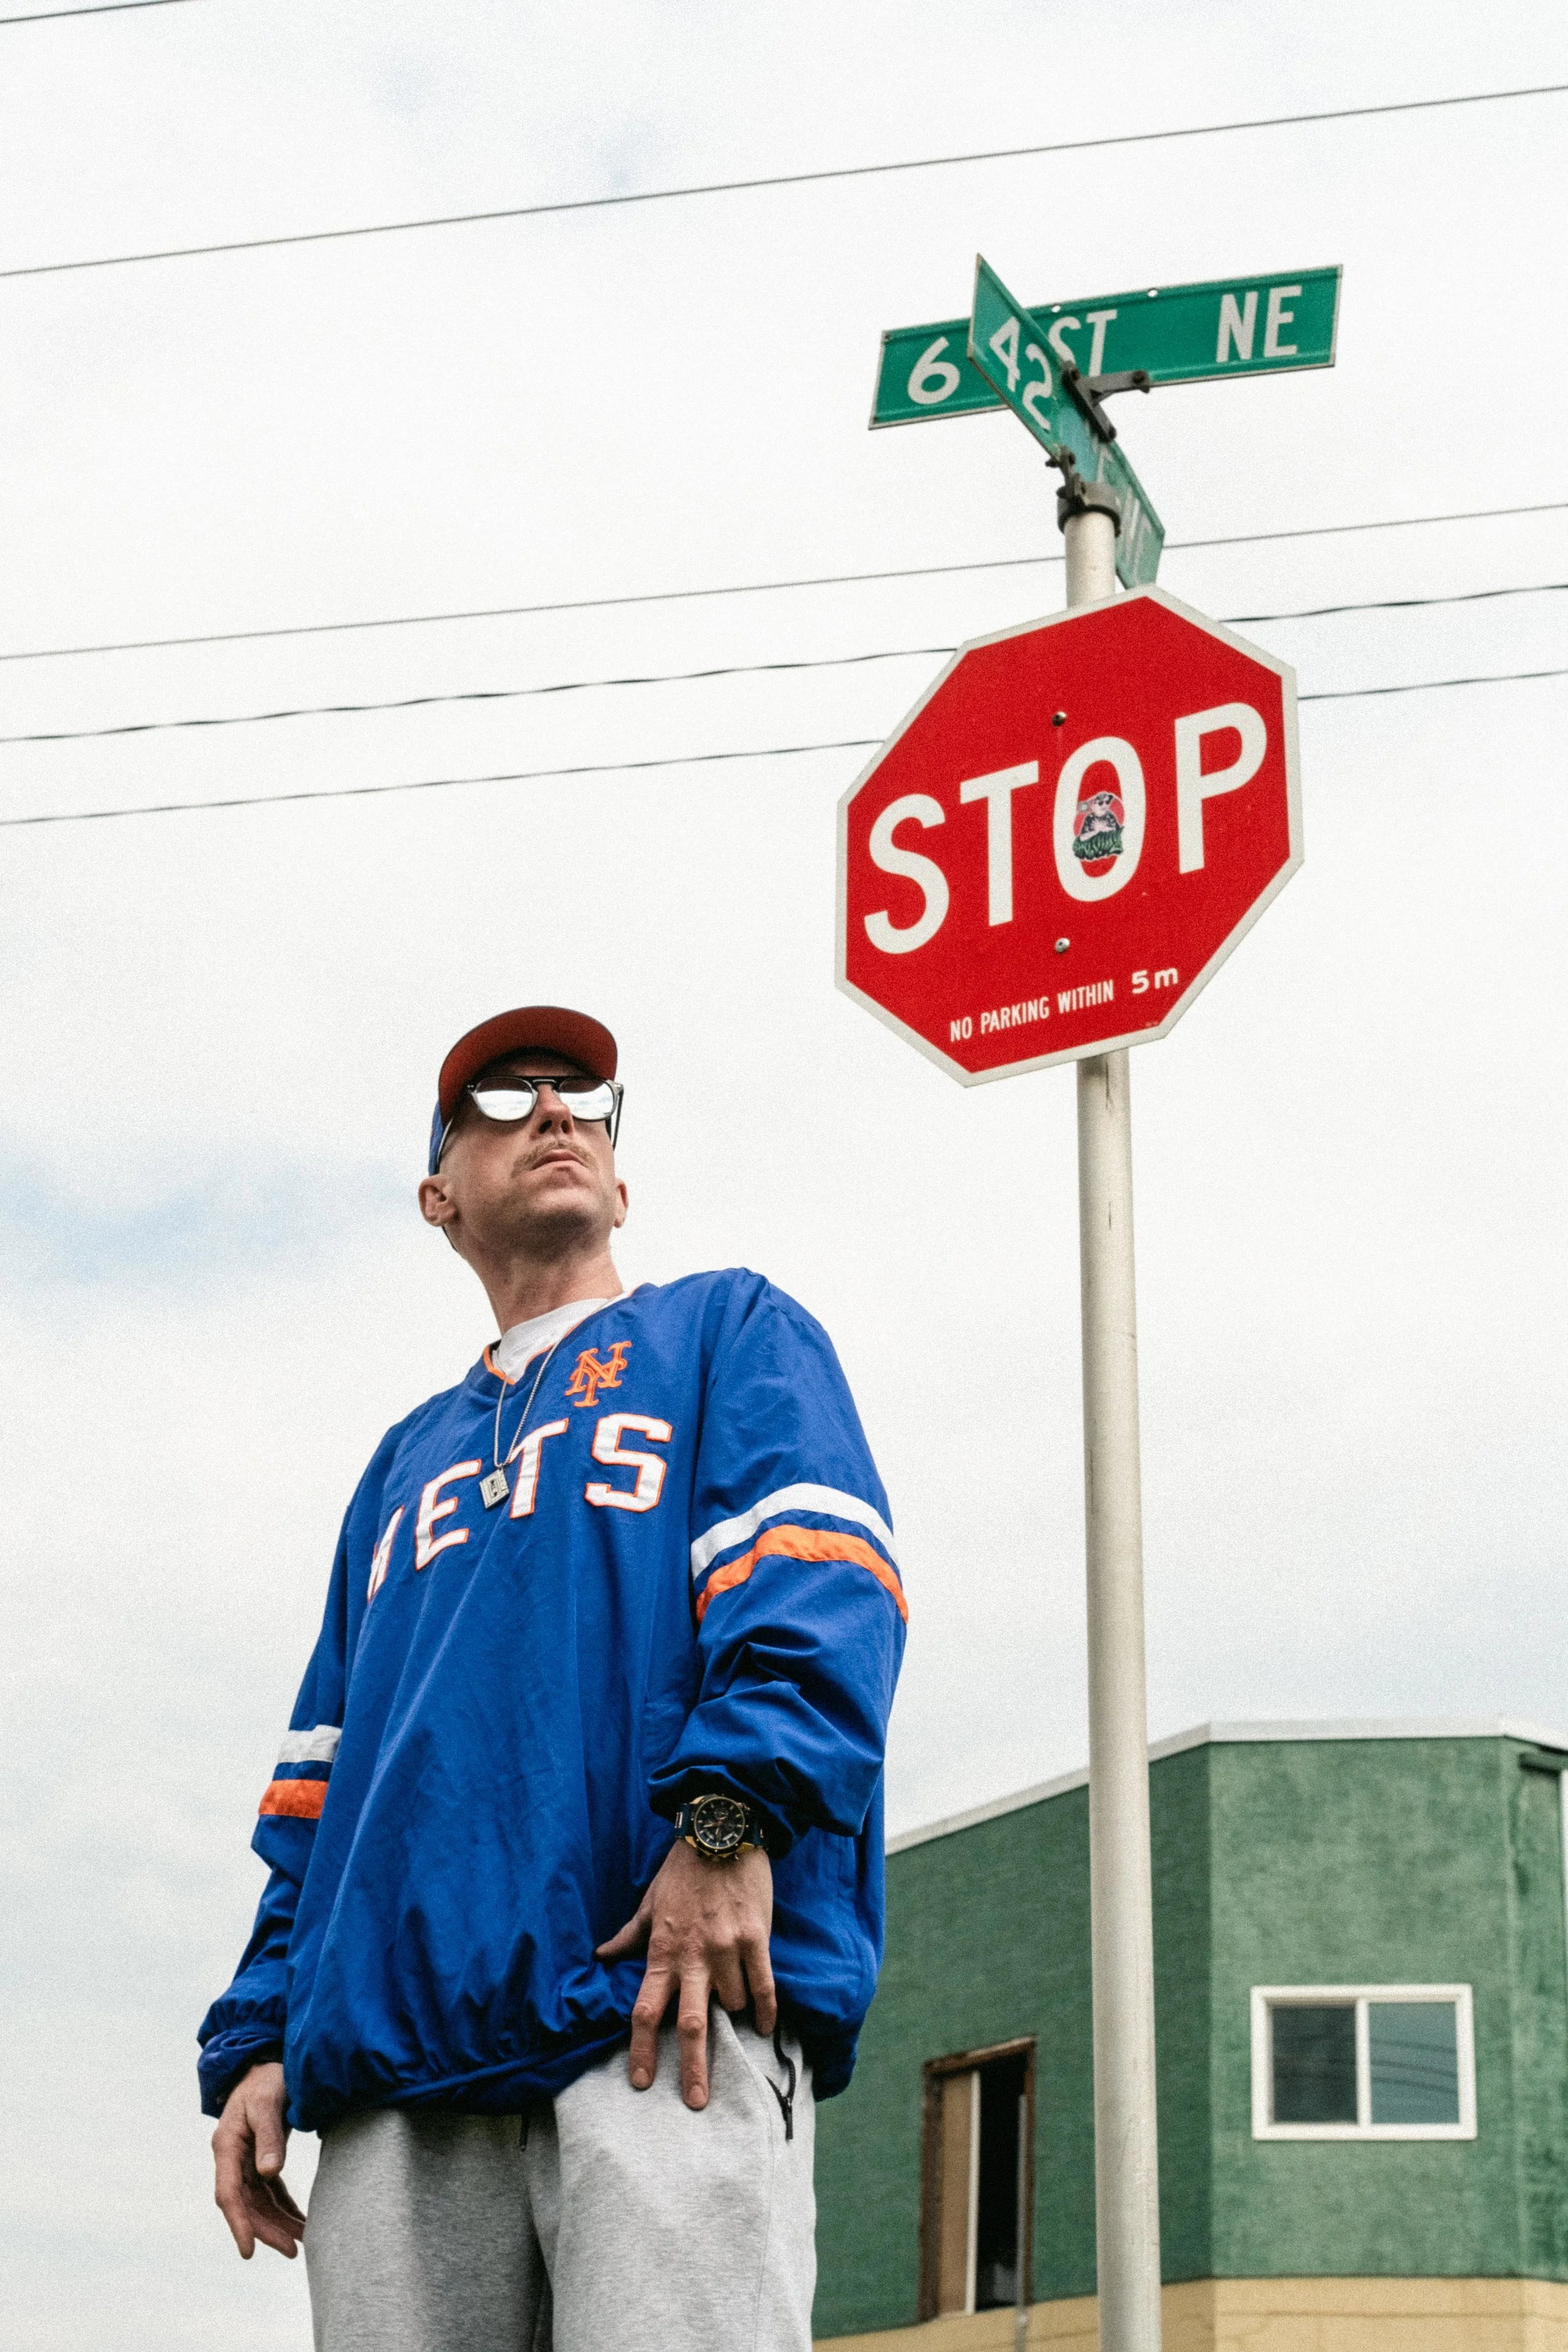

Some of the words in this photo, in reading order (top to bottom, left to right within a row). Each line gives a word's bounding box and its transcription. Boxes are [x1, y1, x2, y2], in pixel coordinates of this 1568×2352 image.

[989, 315, 1053, 432] 42
[1048, 309, 1118, 378] ST
[1216, 285, 1302, 364] NE
[863, 702, 1268, 955] STOP
[950, 1016, 973, 1042] NO
[980, 996, 1050, 1034] PARKING
[1057, 978, 1114, 1014] WITHIN
